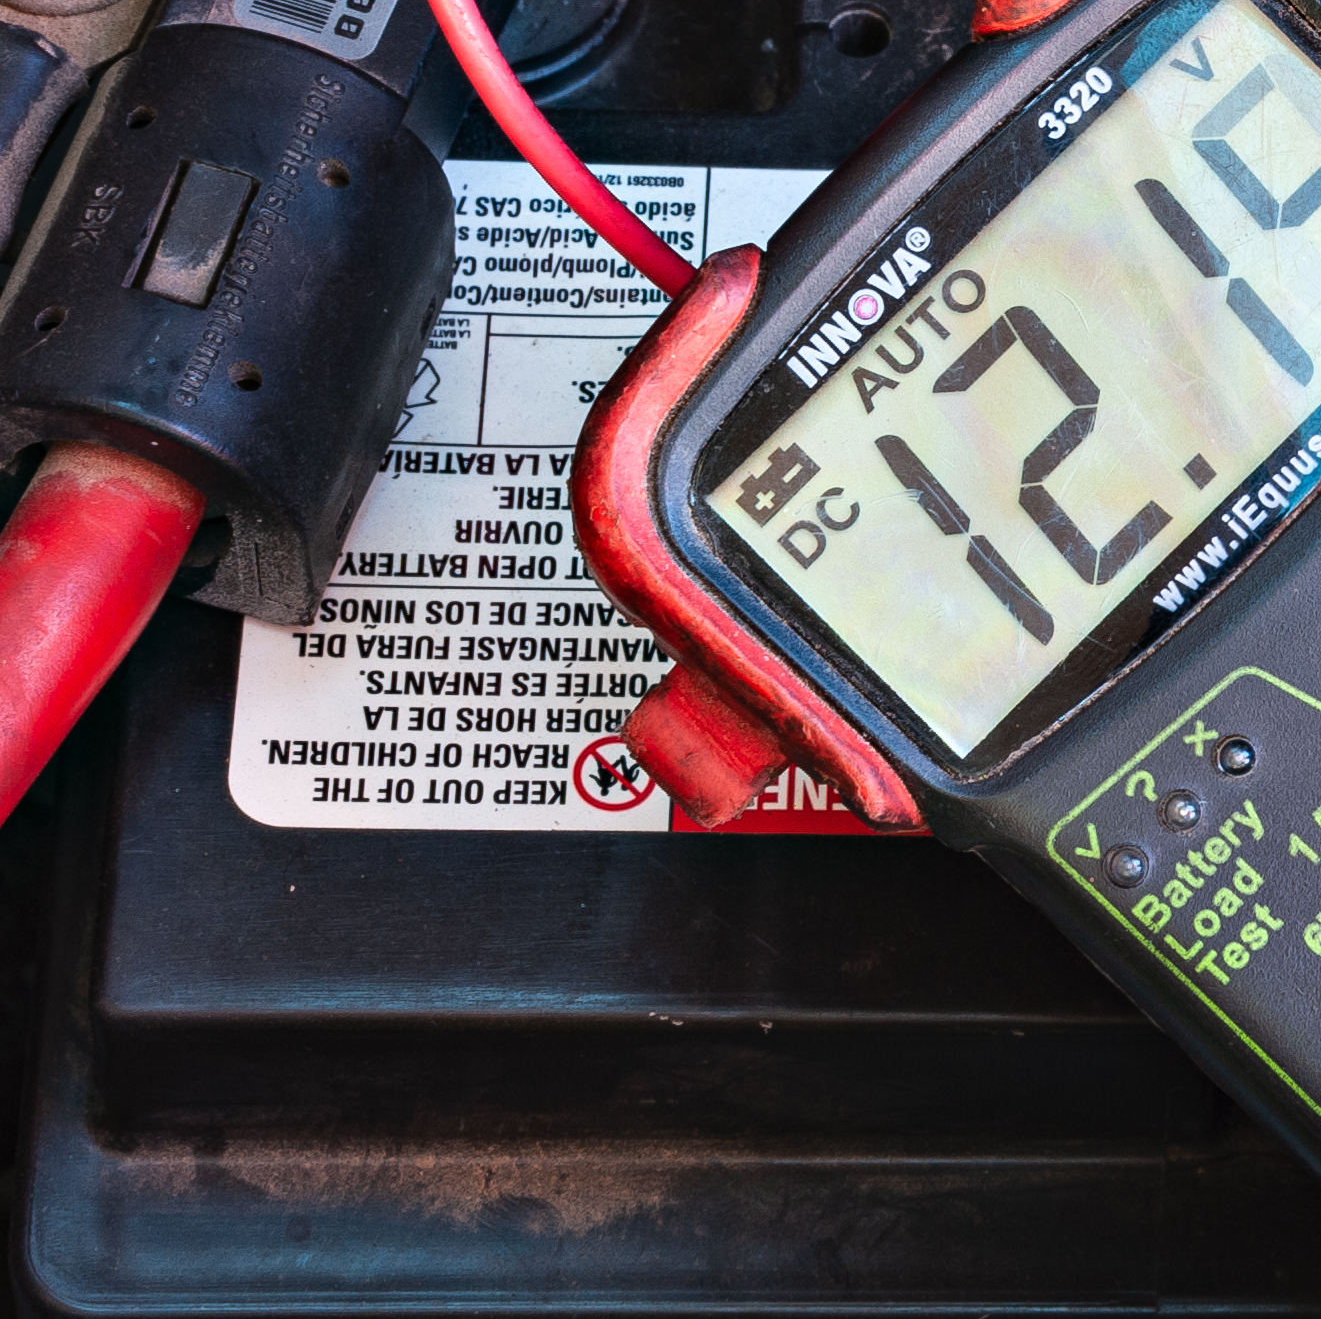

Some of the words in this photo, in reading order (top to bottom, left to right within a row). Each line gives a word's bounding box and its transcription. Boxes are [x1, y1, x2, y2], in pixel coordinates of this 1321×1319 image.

[1170, 38, 1214, 84] V
[1037, 66, 1113, 140] 3320
[475, 196, 521, 217] CAS
[635, 201, 696, 221] ácido
[476, 226, 598, 248] Acid/Acide
[850, 268, 986, 414] AUTO
[377, 449, 495, 479] BATERÍA
[505, 453, 540, 477] LA
[454, 519, 562, 545] OUVRIR
[776, 486, 862, 570] DC
[478, 554, 557, 580] OPEN
[426, 600, 479, 625] LOS
[489, 601, 526, 626] DE
[292, 632, 346, 658] DEL
[356, 634, 450, 659] FUERA
[459, 636, 668, 668] MANTÉNGASE
[359, 669, 502, 695] ENFANTS.
[512, 672, 546, 695] ES
[556, 673, 666, 704] ORTÉE
[362, 706, 399, 730] LA
[409, 707, 446, 731] DE
[456, 707, 536, 732] HORS
[261, 739, 417, 767] CHILDREN.
[425, 742, 462, 768] OF
[472, 743, 570, 769] REACH
[312, 776, 370, 803] THE
[377, 778, 415, 803] OF
[422, 778, 484, 805] OUT
[493, 779, 567, 806] KEEP
[1131, 799, 1264, 933] Battery
[1163, 857, 1264, 960] Load
[1195, 903, 1284, 985] Test
